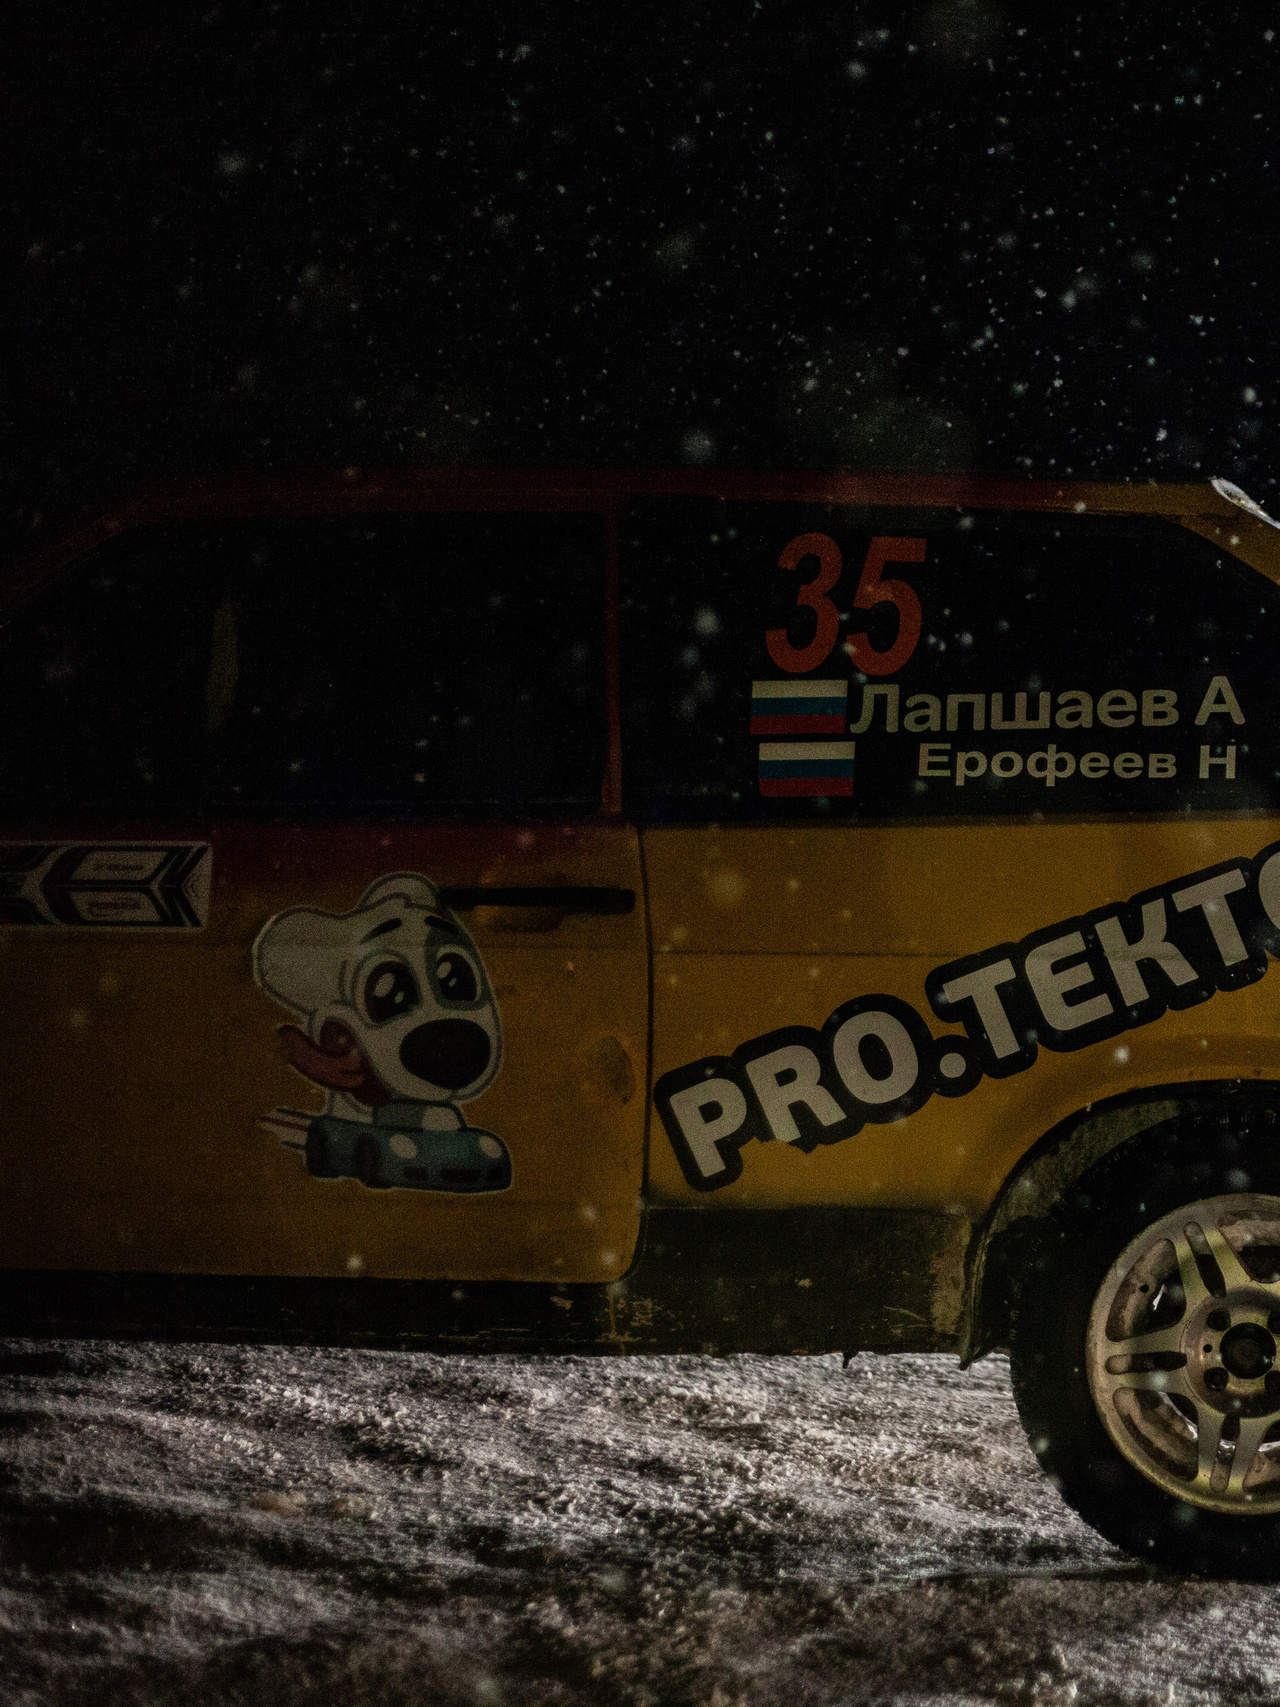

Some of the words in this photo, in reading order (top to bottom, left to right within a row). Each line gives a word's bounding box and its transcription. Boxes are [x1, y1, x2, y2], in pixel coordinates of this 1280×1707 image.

[765, 532, 927, 676] 35
[850, 684, 1180, 734] Лапшаев
[1194, 675, 1246, 726] А
[917, 743, 1178, 787] Ерофеев
[1200, 744, 1237, 780] Н
